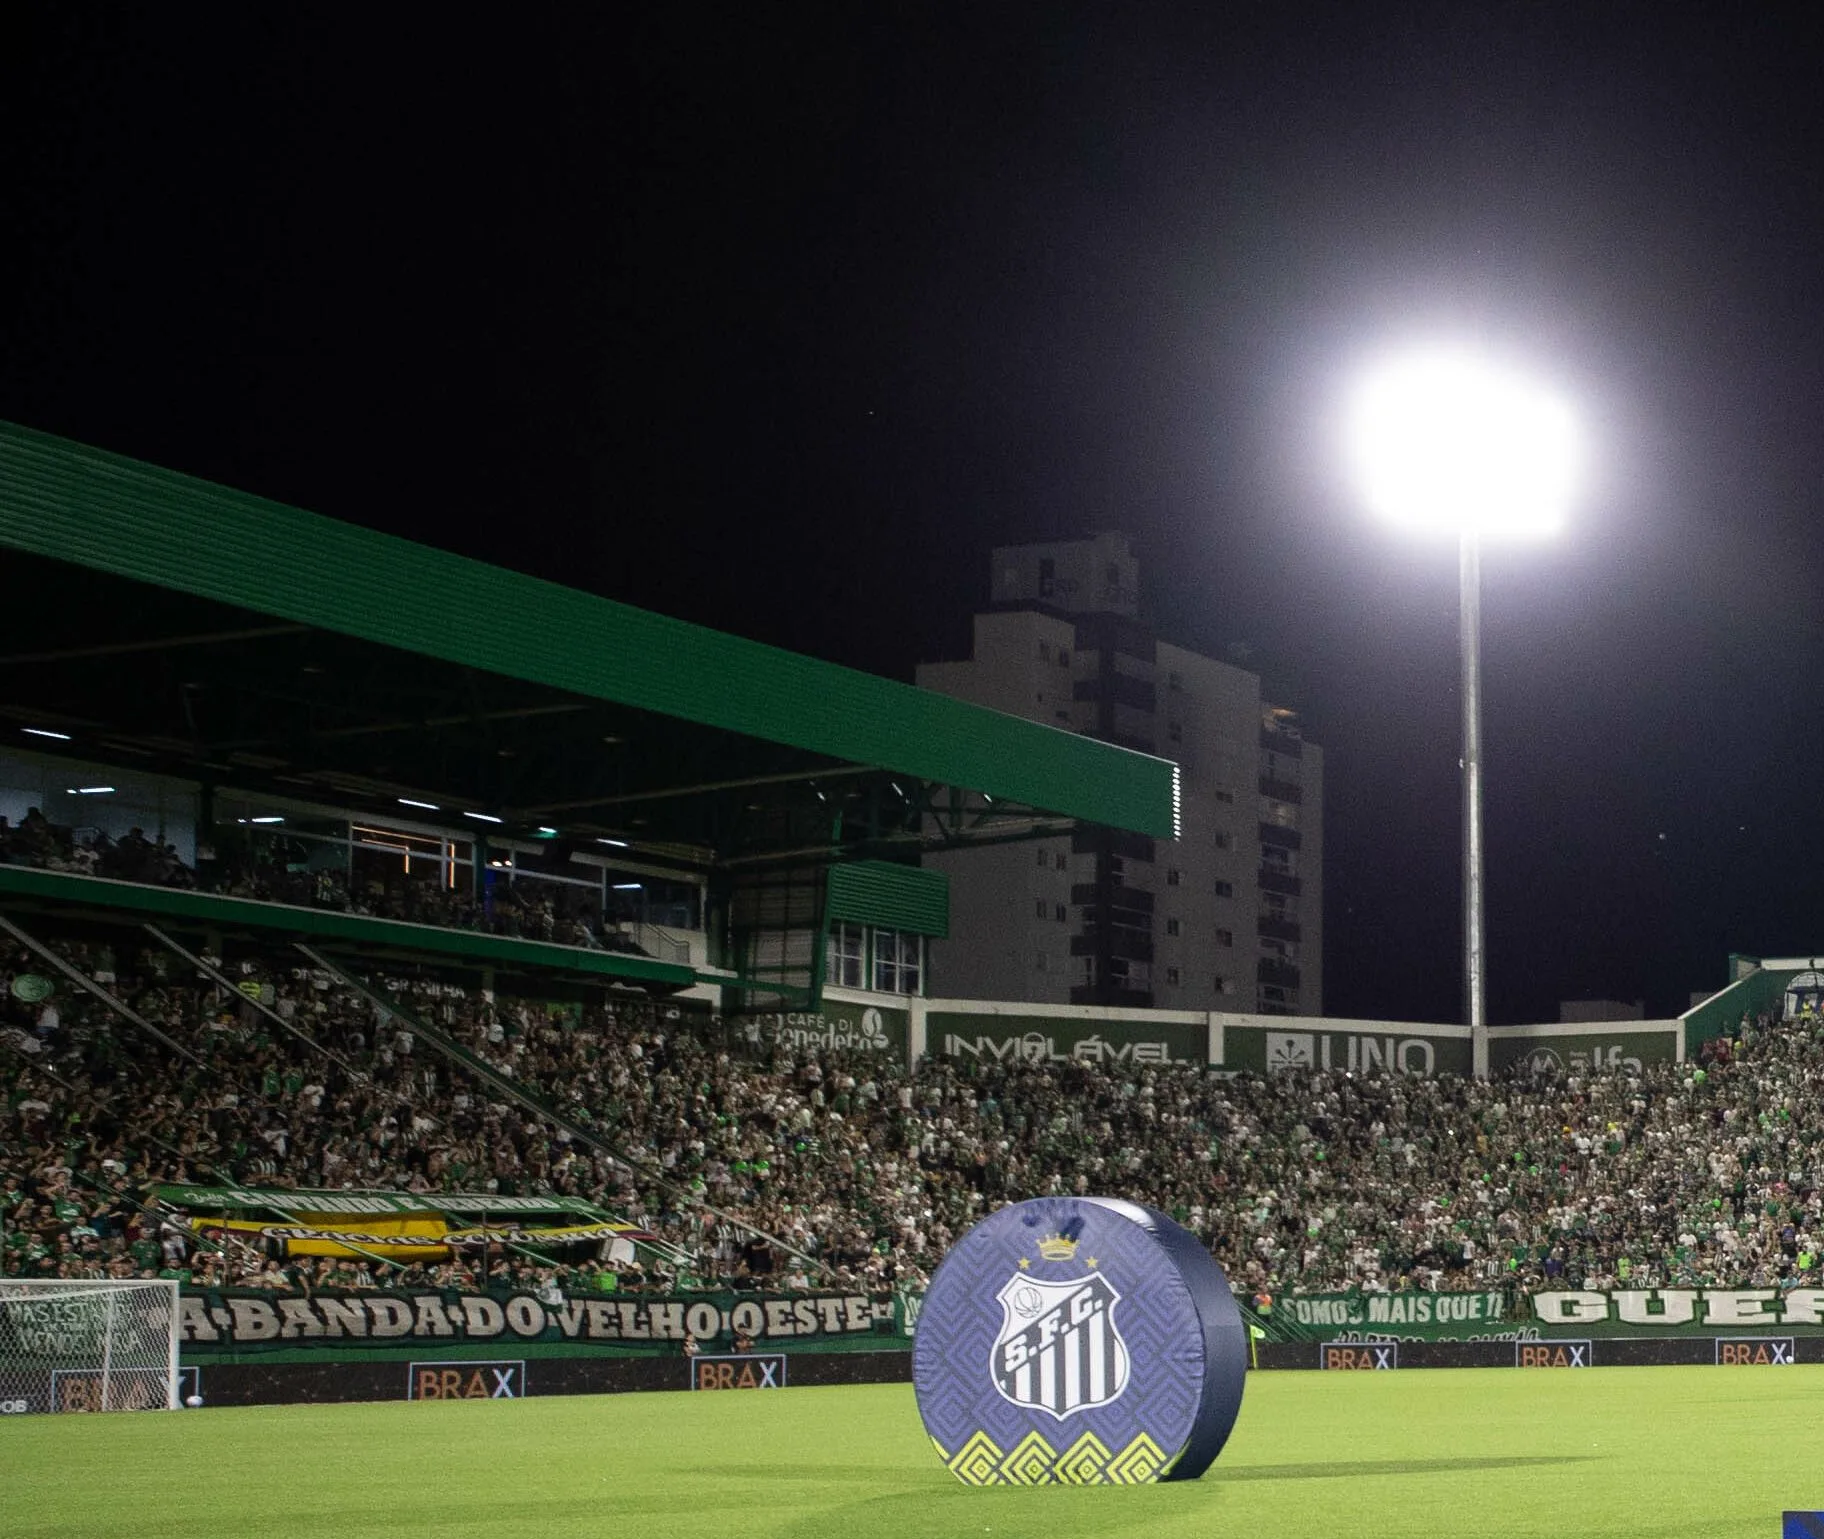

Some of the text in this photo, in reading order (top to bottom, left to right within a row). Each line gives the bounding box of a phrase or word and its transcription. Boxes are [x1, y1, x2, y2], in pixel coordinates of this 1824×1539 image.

[788, 1011, 825, 1029] CAFÉ
[1320, 1035, 1436, 1079] UNO
[233, 1296, 451, 1341] BANDA
[463, 1296, 546, 1337] DO
[556, 1299, 721, 1340] VELHO
[730, 1296, 872, 1337] OESTE
[1281, 1297, 1363, 1325] SOMOS
[1368, 1294, 1432, 1324] MAIS
[1435, 1294, 1483, 1323] QUE
[1327, 1348, 1390, 1370] BRAX
[1521, 1346, 1585, 1368] BRAX
[1722, 1344, 1787, 1365] BRAX
[418, 1369, 515, 1400] BRAX
[699, 1362, 777, 1390] BRAX
